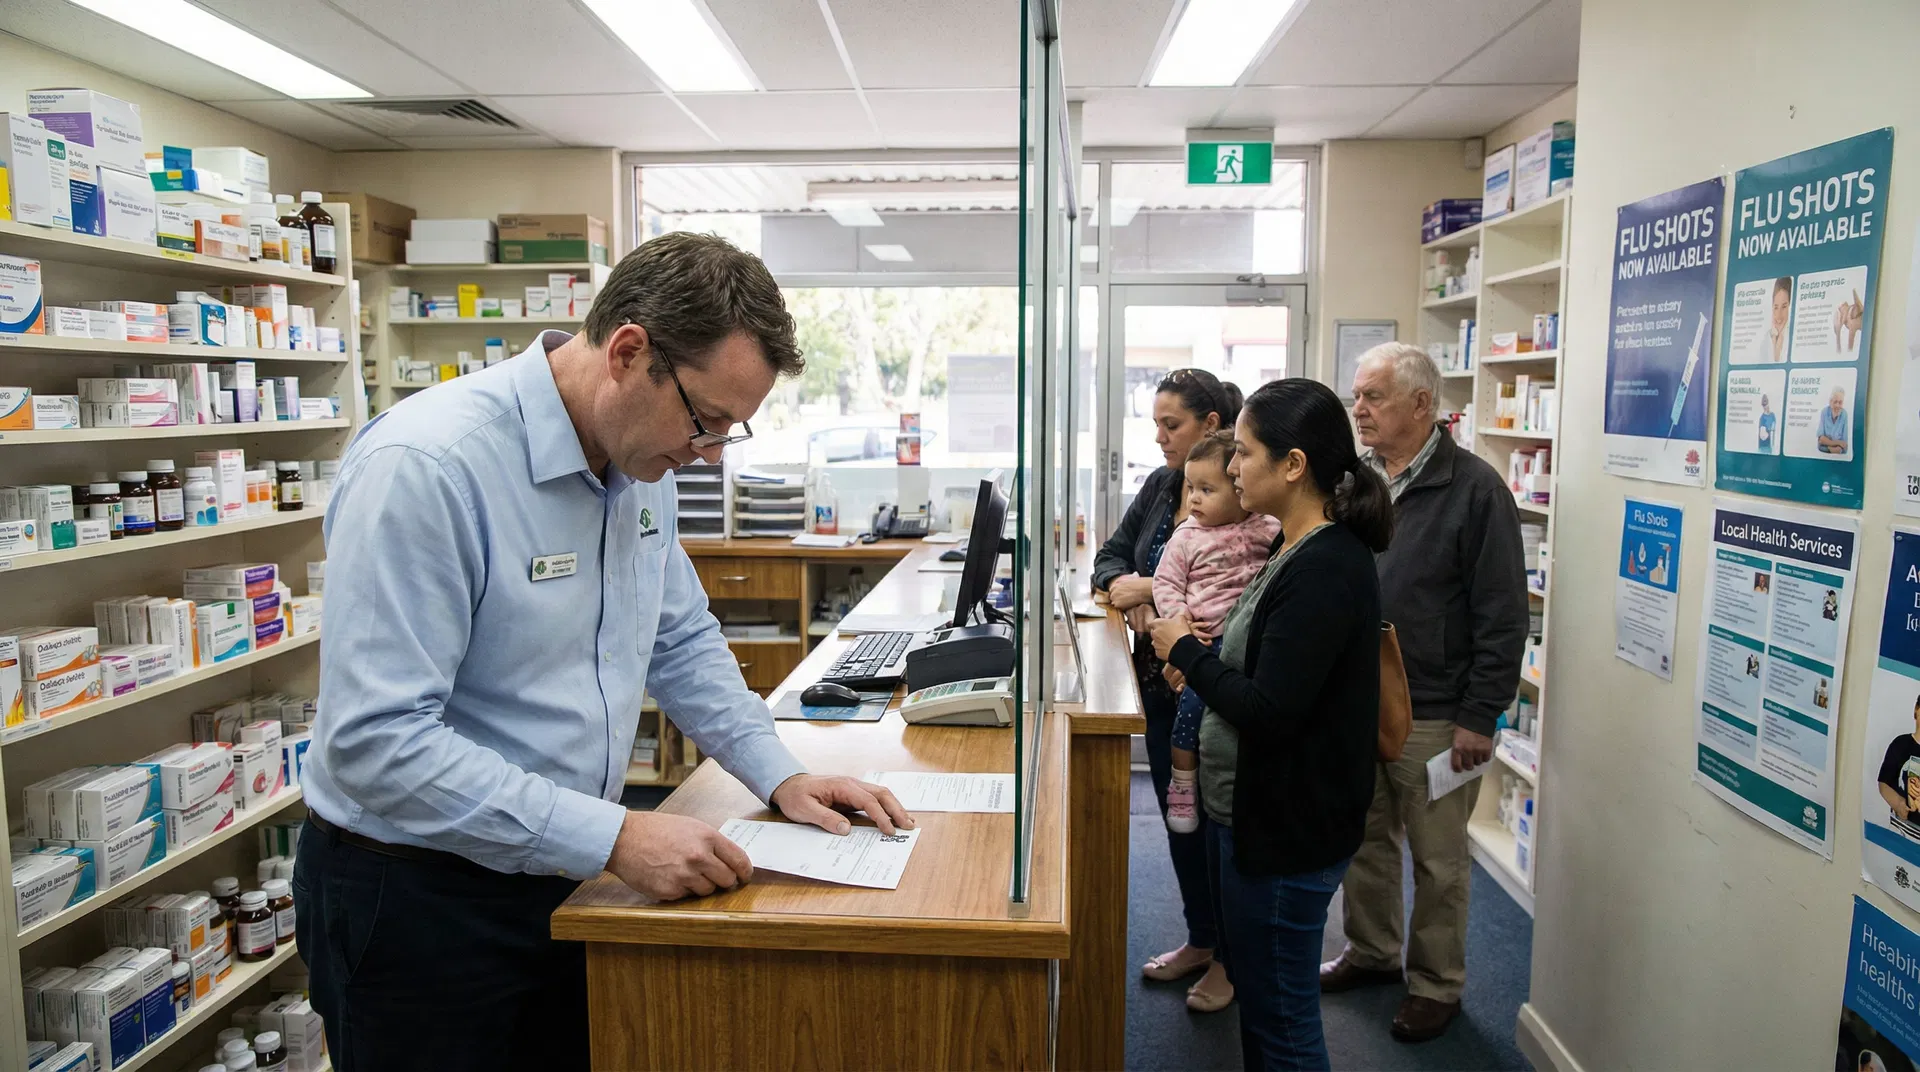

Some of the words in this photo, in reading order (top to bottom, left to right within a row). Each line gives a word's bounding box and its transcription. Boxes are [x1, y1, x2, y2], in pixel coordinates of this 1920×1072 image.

[1740, 190, 1783, 231] FLU
[1787, 167, 1876, 220] SHOTS
[1620, 223, 1650, 256] FLU
[1653, 206, 1714, 249] SHOTS
[1738, 232, 1774, 259] NOW
[1776, 211, 1873, 252] AVAILABLE
[1618, 258, 1645, 280] NOW
[1646, 243, 1713, 276] AVAILABLE
[1634, 509, 1645, 523] Flu
[1721, 519, 1748, 540] Local
[1750, 525, 1787, 548] Health
[1789, 532, 1843, 559] Services
[1859, 950, 1915, 1011] healths
